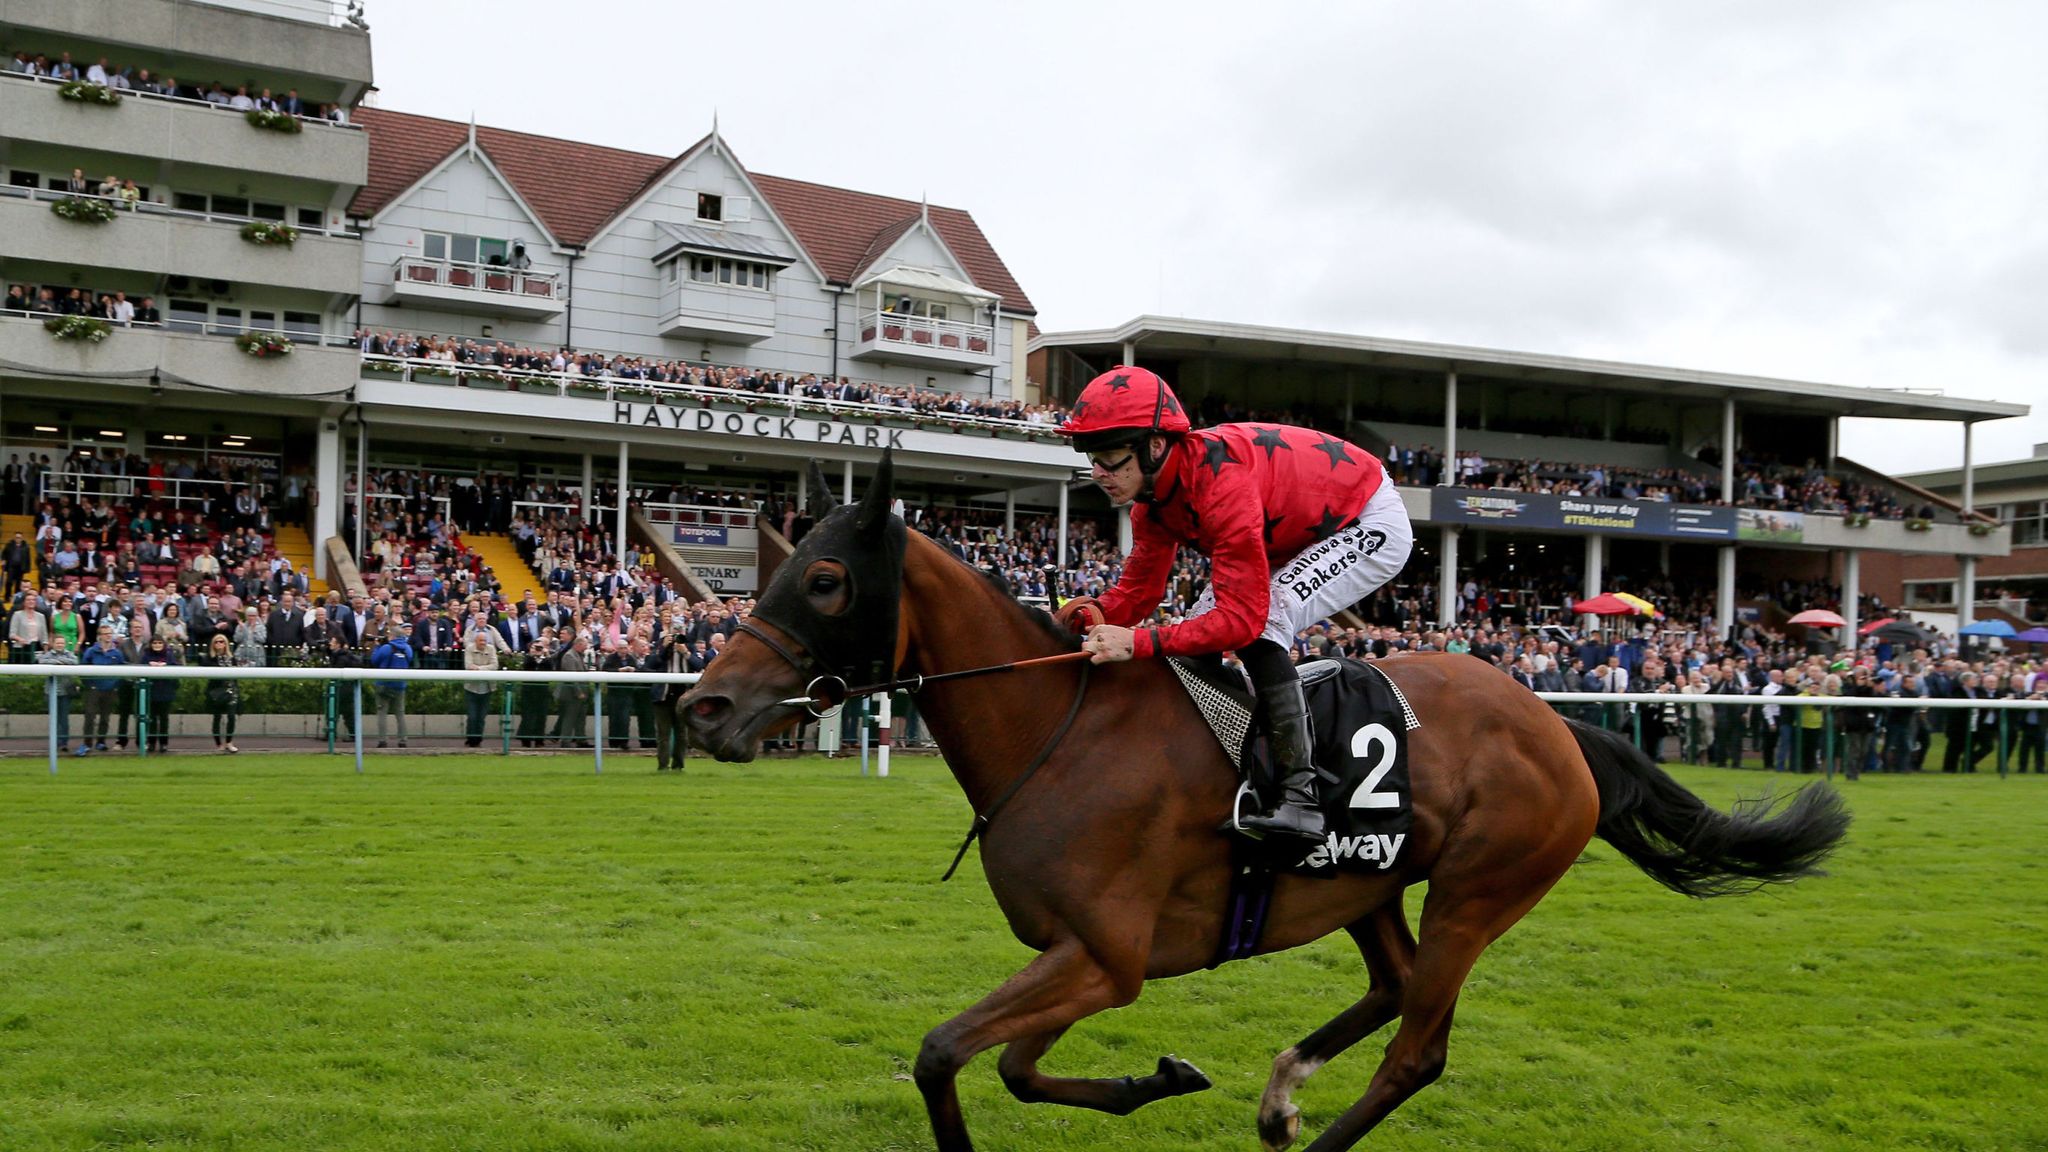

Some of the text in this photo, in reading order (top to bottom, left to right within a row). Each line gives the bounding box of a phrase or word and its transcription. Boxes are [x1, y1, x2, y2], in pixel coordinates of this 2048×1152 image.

[615, 403, 903, 449] HAYDOCK PARK
[1560, 500, 1640, 517] Share your day
[1563, 514, 1636, 529] #TENsational
[680, 528, 721, 536] TOTEPOOL
[1278, 534, 1354, 585] Gallowas
[1291, 550, 1358, 602] Bakers
[1348, 722, 1400, 809] 2
[1295, 830, 1406, 870] etway
